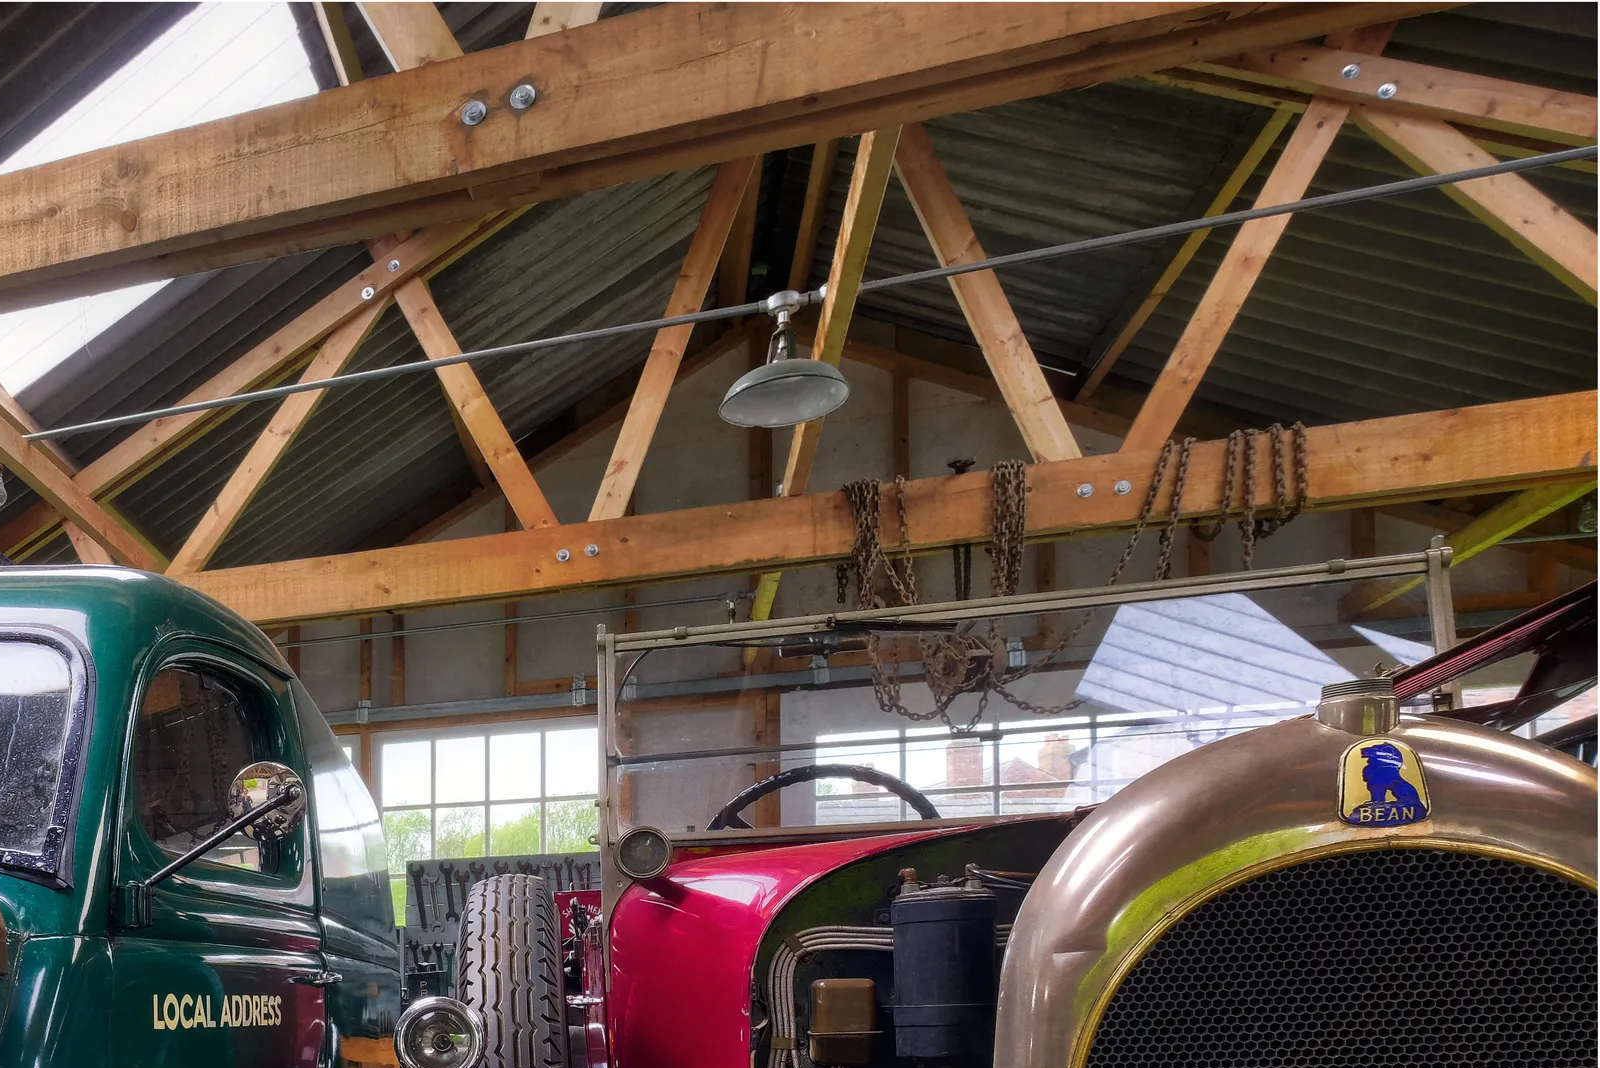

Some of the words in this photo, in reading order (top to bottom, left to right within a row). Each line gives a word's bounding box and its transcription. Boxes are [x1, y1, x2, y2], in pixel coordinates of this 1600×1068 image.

[1359, 806, 1415, 823] BEAN
[153, 993, 216, 1030] LOCAL
[220, 994, 282, 1028] ADDRESS
